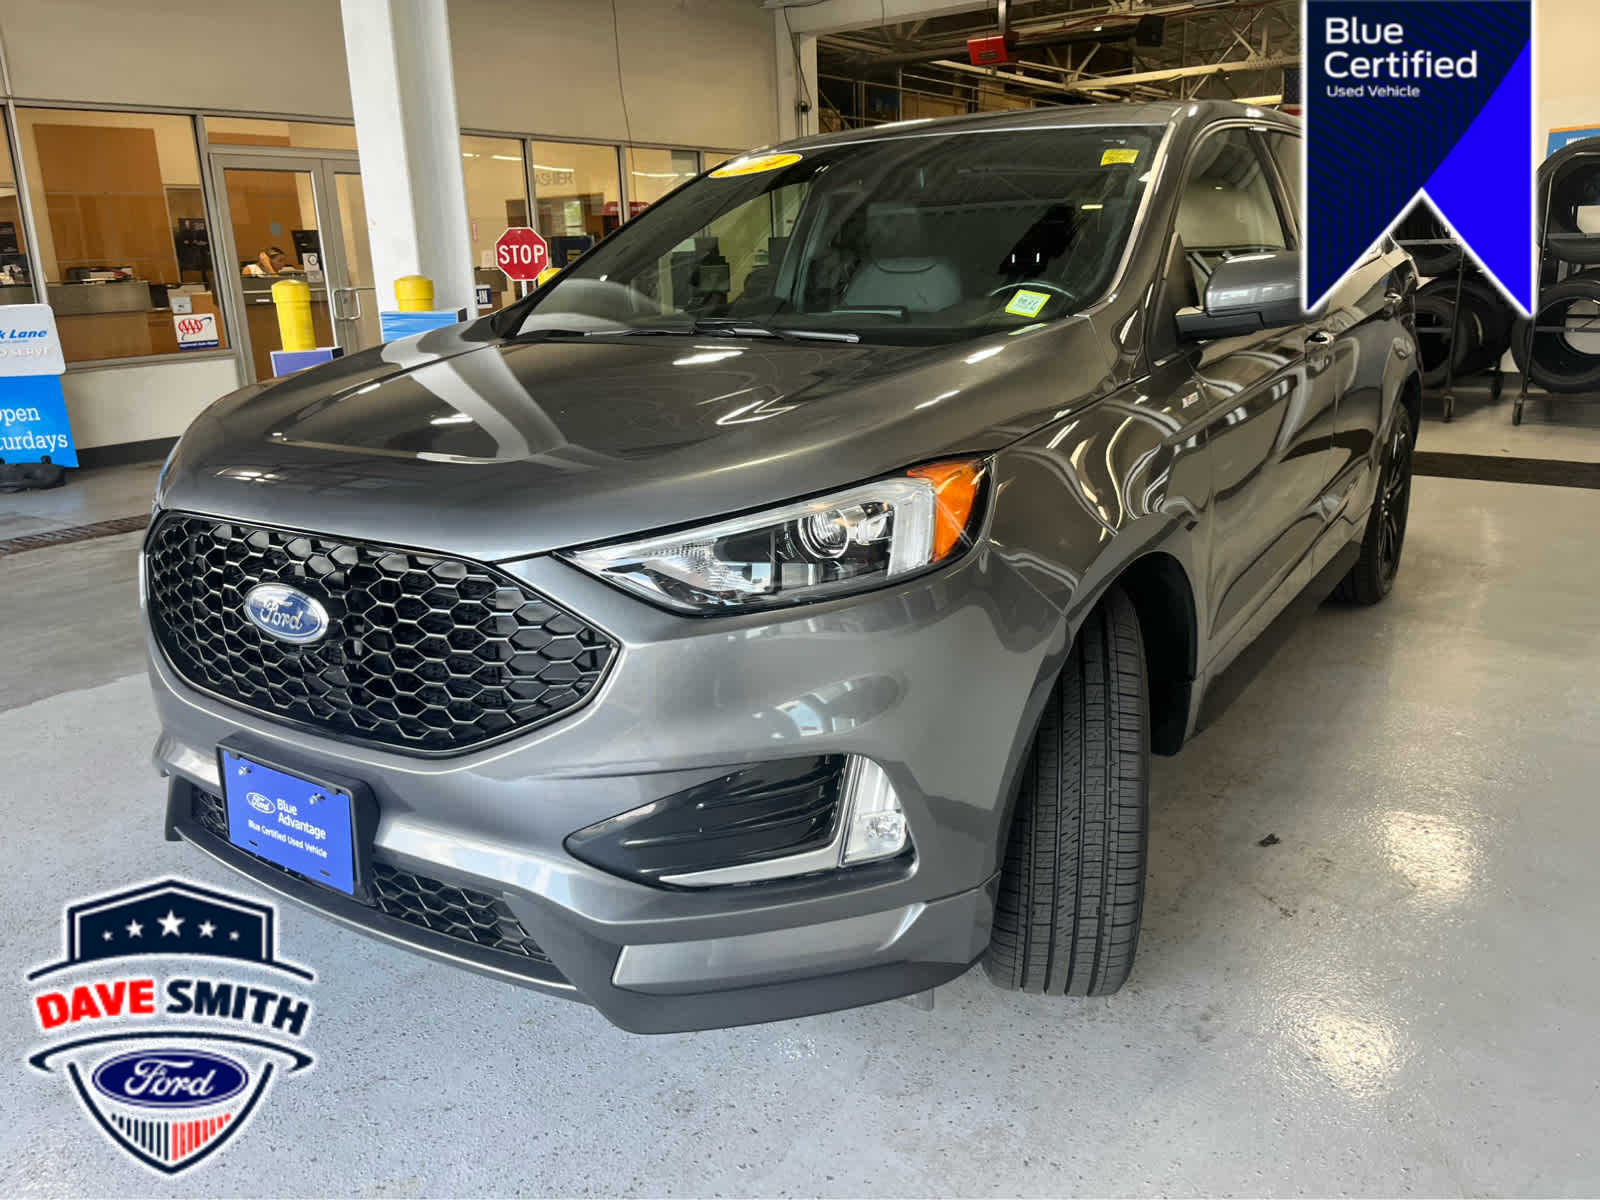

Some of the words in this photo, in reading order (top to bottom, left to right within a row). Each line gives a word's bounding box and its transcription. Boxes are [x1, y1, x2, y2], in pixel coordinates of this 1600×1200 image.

[499, 244, 545, 265] STOP
[9, 328, 48, 339] Lane
[178, 319, 203, 335] AAA
[0, 407, 40, 426] pen
[260, 599, 303, 630] Ford
[276, 798, 298, 816] Blue
[278, 812, 327, 840] Advantage
[248, 819, 261, 832] Blue
[261, 825, 287, 843] Certified
[287, 835, 304, 849] Used
[304, 842, 328, 859] Vehicle
